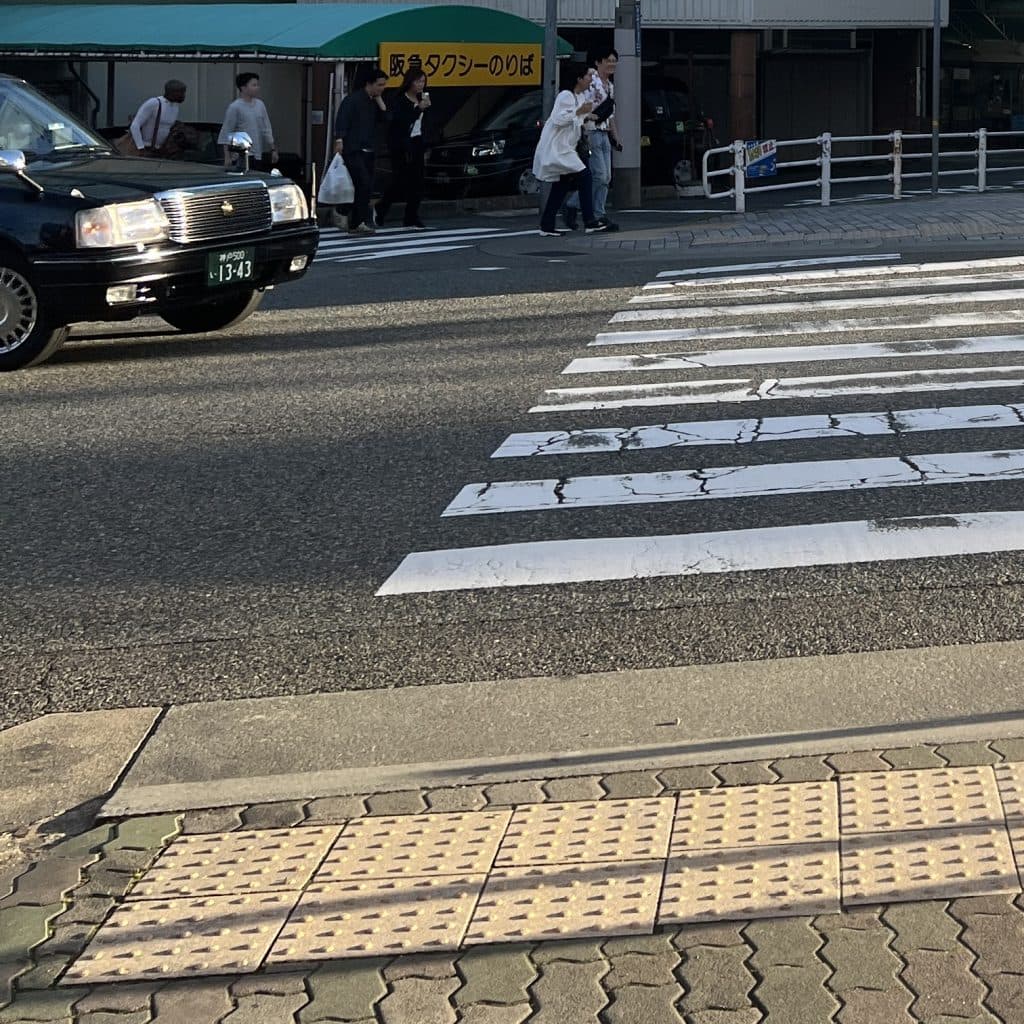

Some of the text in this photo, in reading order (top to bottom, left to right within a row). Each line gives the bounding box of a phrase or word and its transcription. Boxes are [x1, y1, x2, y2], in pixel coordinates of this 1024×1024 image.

[389, 53, 535, 77] 阪急タクシーのりば
